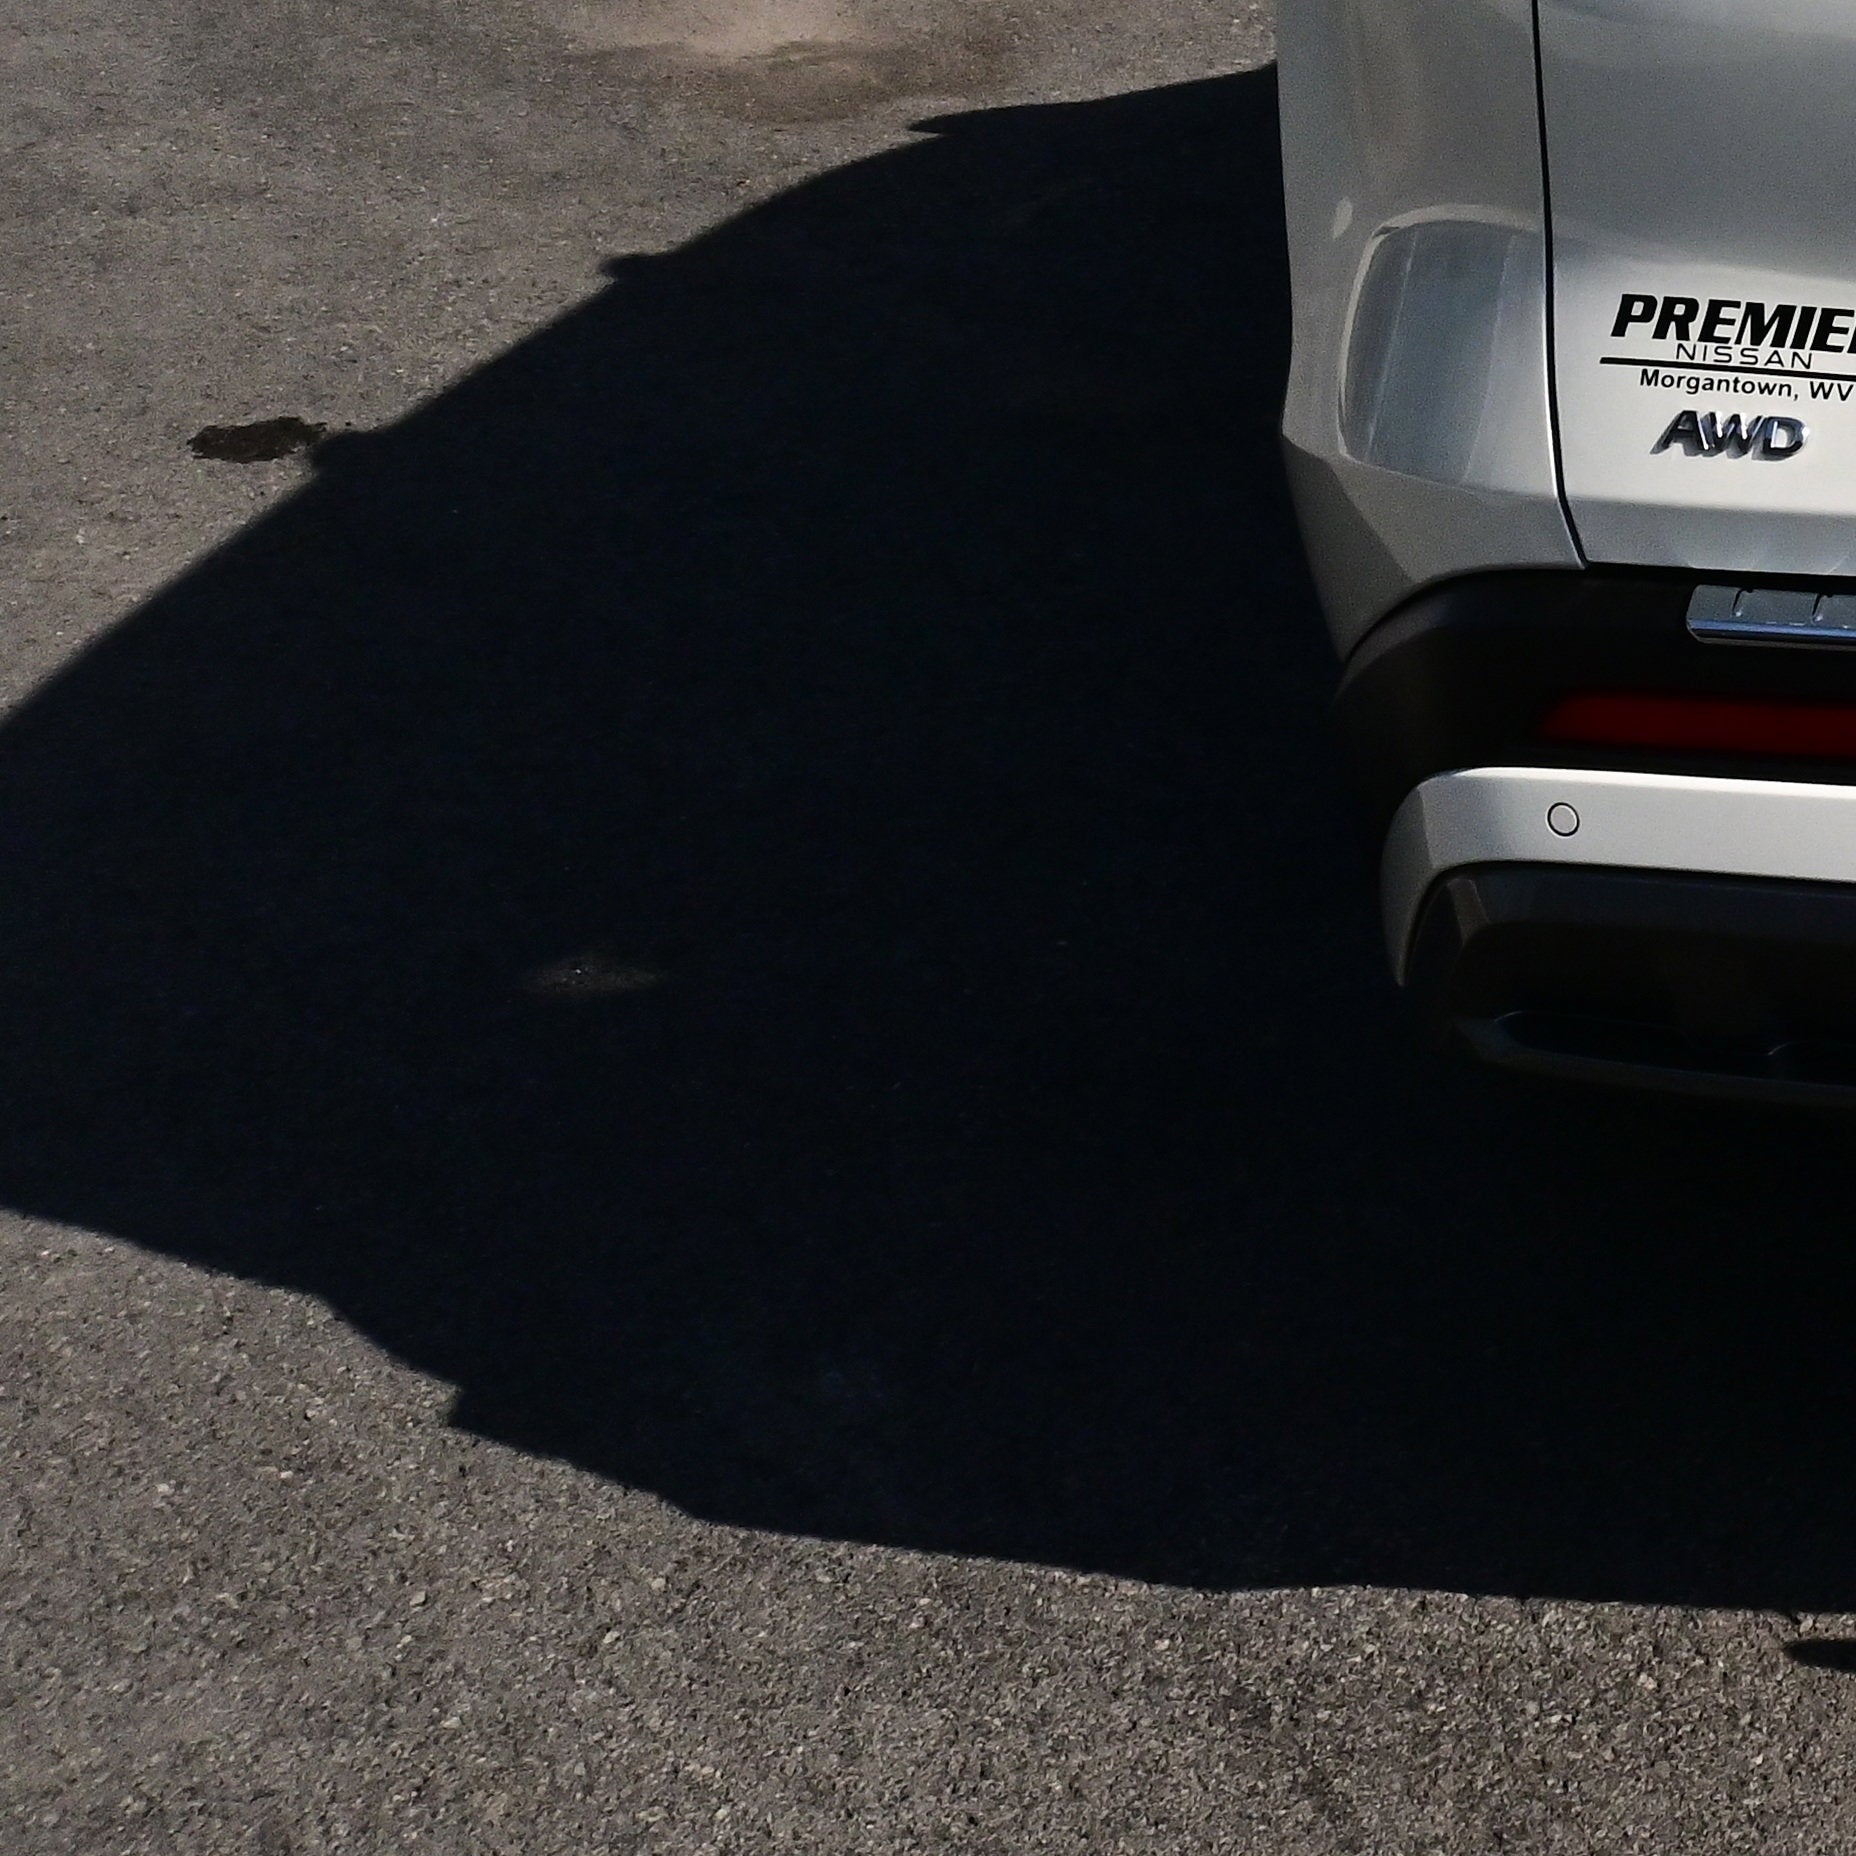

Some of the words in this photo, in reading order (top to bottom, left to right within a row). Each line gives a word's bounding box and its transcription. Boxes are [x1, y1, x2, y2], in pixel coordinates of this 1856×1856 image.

[1675, 343, 1814, 370] NISSAN
[1639, 368, 1800, 402] Morgantown,
[1809, 380, 1855, 402] WV
[1652, 409, 1810, 461] AWD
